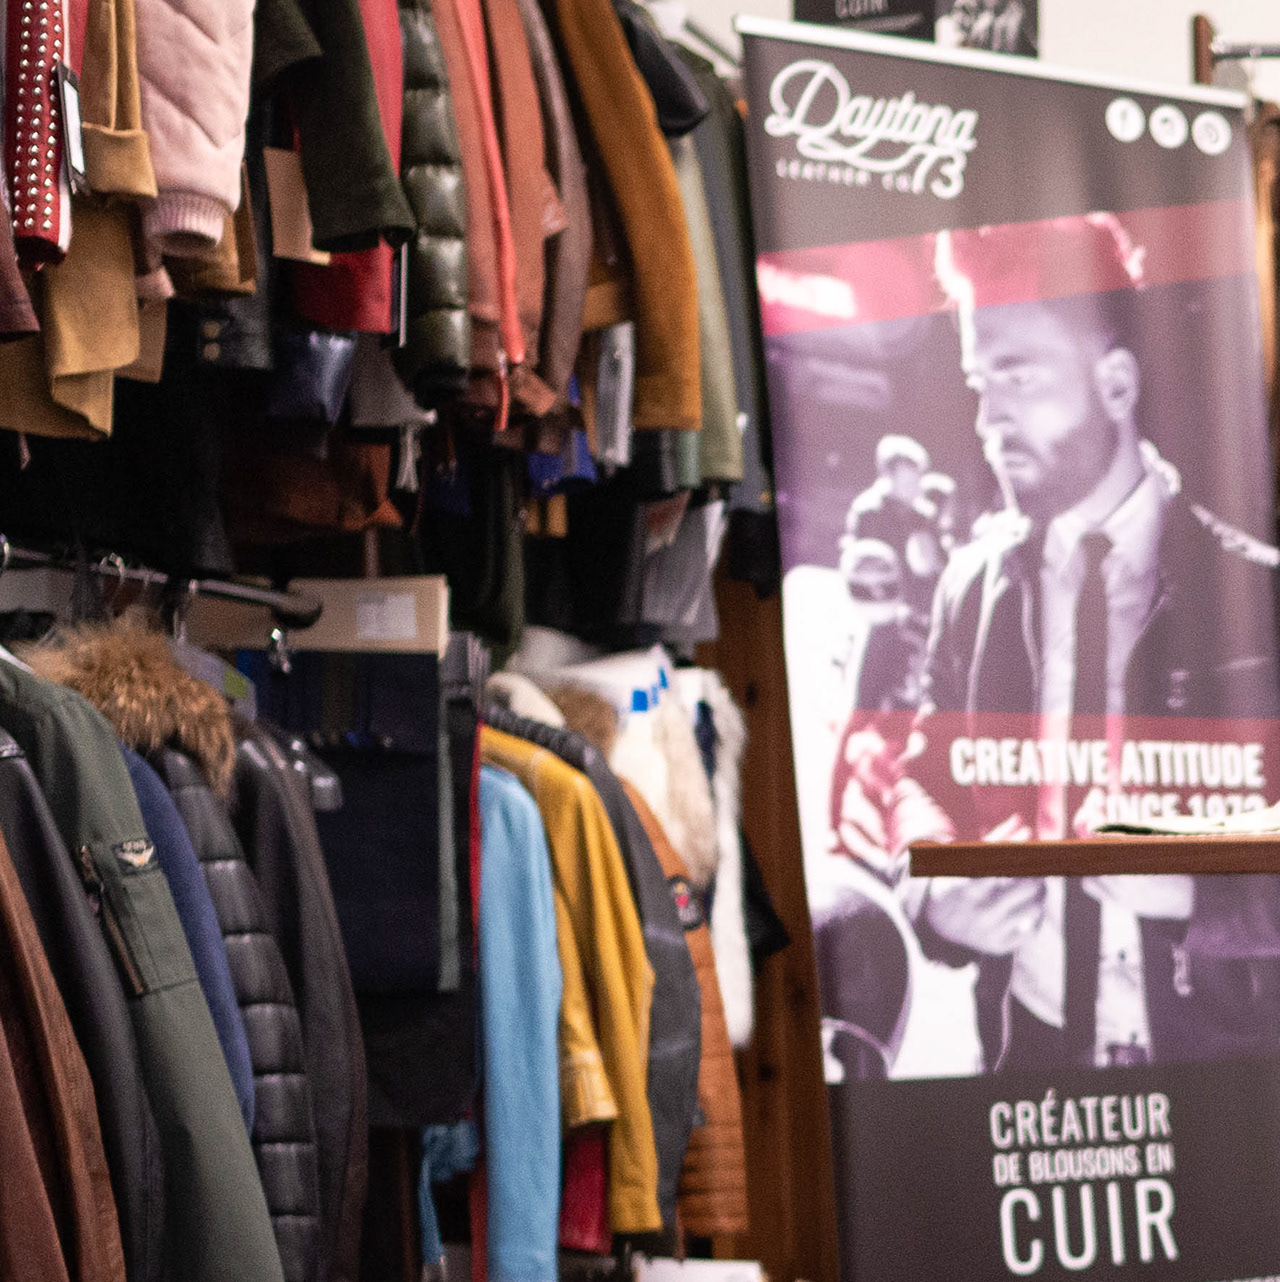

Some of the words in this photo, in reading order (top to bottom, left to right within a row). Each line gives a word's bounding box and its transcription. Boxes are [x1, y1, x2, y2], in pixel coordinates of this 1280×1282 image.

[764, 58, 979, 172] Daytona
[950, 737, 1109, 786] CREATIVE
[1121, 740, 1265, 788] ATTITUDE
[990, 1087, 1171, 1149] CRÉATEUR
[993, 1152, 1023, 1187] DE
[1028, 1143, 1142, 1185] BLOUSONS
[1145, 1142, 1176, 1174] EN
[1000, 1177, 1179, 1277] CUIR
